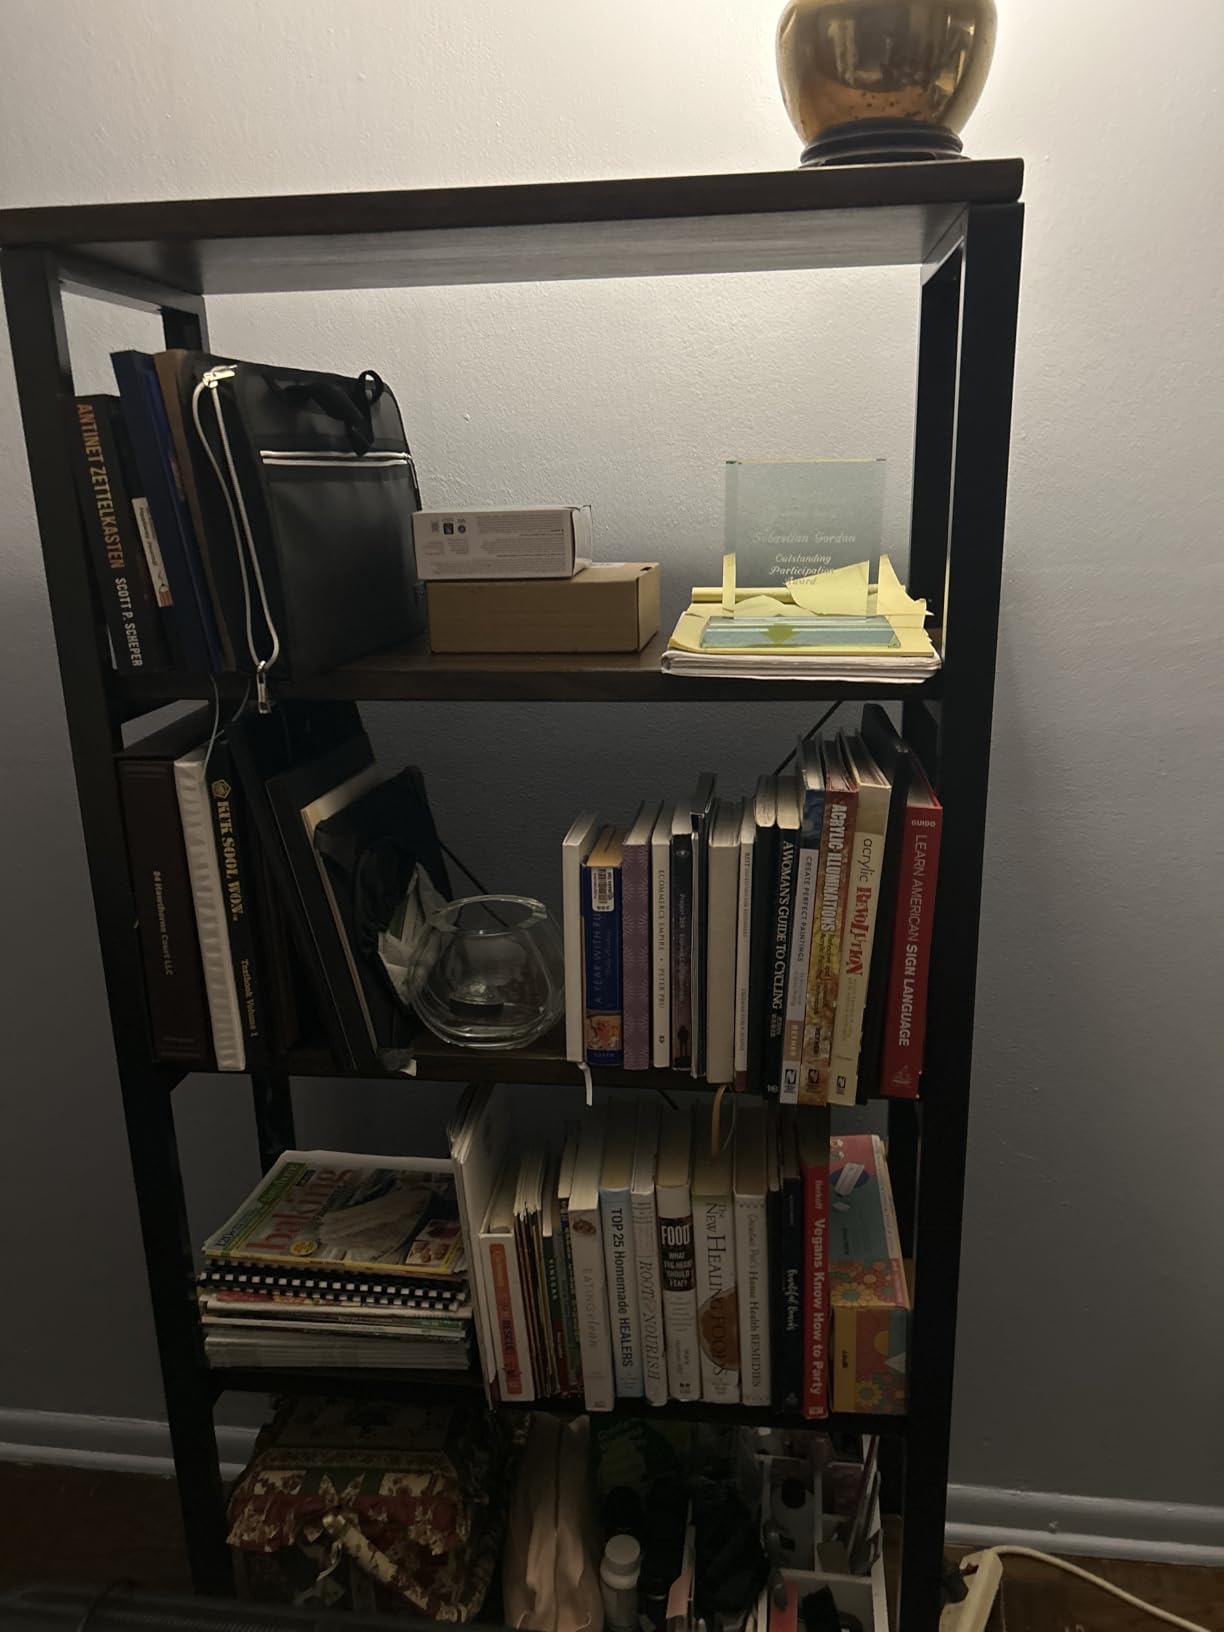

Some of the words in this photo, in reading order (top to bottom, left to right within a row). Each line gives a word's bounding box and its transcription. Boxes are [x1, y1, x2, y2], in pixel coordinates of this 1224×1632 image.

[76, 403, 104, 462] ANTINET
[90, 466, 125, 569] ZETTELKASTEN
[769, 566, 834, 576] Participation
[776, 554, 832, 564] Outstanding
[115, 577, 132, 610] SCOTT
[122, 611, 134, 620] P.
[124, 623, 143, 667] SCHEPER
[216, 800, 230, 834] KUK
[828, 804, 847, 850] ACRYLIC
[911, 819, 936, 828] GUIDO
[221, 837, 237, 879] SOOL
[803, 856, 812, 885] CREATE
[858, 838, 875, 883] acrylic
[912, 834, 928, 877] LEARN
[227, 880, 243, 915] WON
[801, 887, 809, 920] PERFECT
[820, 852, 841, 931] ILLUMINATIONS
[776, 907, 789, 942] GUIDE
[906, 879, 924, 942] AMERICAN
[161, 934, 170, 959] Court
[593, 931, 601, 962] WITH
[775, 944, 785, 959] TO
[797, 922, 806, 962] PAINTINGS
[164, 960, 173, 975] LLC
[904, 944, 918, 975] SIGN
[241, 958, 252, 998] Textbook
[772, 961, 784, 1010] CYCLING
[246, 999, 256, 1030] Volume
[898, 979, 915, 1047] LANGUAGE
[611, 1208, 623, 1231] TOP
[706, 1202, 718, 1233] NEW
[613, 1234, 624, 1247] 25
[661, 1225, 690, 1246] FOOD
[813, 1218, 825, 1268] Vegans
[614, 1251, 629, 1313] Homemade
[639, 1261, 655, 1298] ROOT
[707, 1235, 727, 1309] HEALING
[748, 1271, 760, 1299] Home
[583, 1268, 595, 1313] EATING
[813, 1272, 824, 1308] Know
[750, 1301, 761, 1331] Health
[813, 1312, 824, 1341] How
[619, 1317, 633, 1367] HEALERS
[643, 1313, 660, 1380] NOURISH
[813, 1344, 822, 1357] to
[751, 1334, 761, 1387] REMEDIES
[810, 1361, 823, 1395] Party
